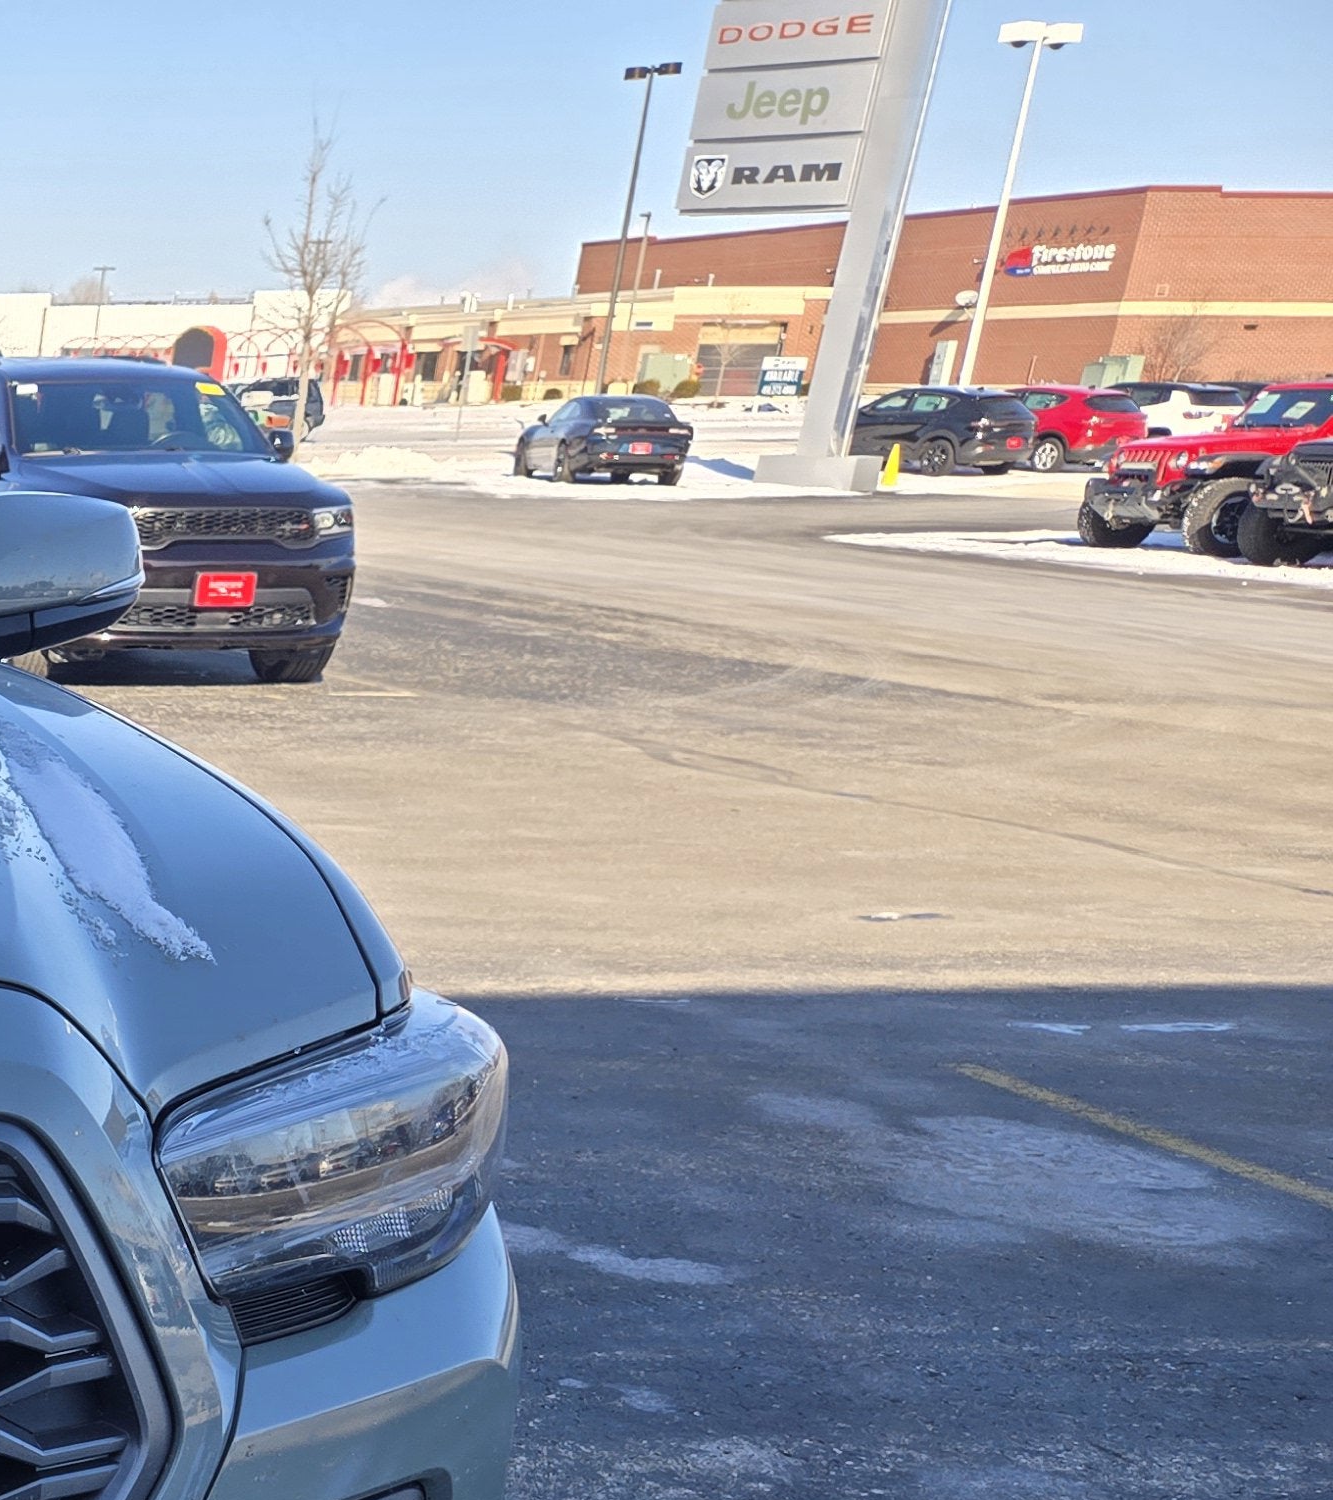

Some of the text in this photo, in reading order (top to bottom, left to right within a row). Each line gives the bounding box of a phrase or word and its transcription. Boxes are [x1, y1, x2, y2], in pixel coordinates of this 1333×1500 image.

[717, 14, 875, 45] DODGE
[725, 80, 831, 126] Jeep
[730, 162, 843, 185] RAM
[1031, 243, 1117, 267] Firestone
